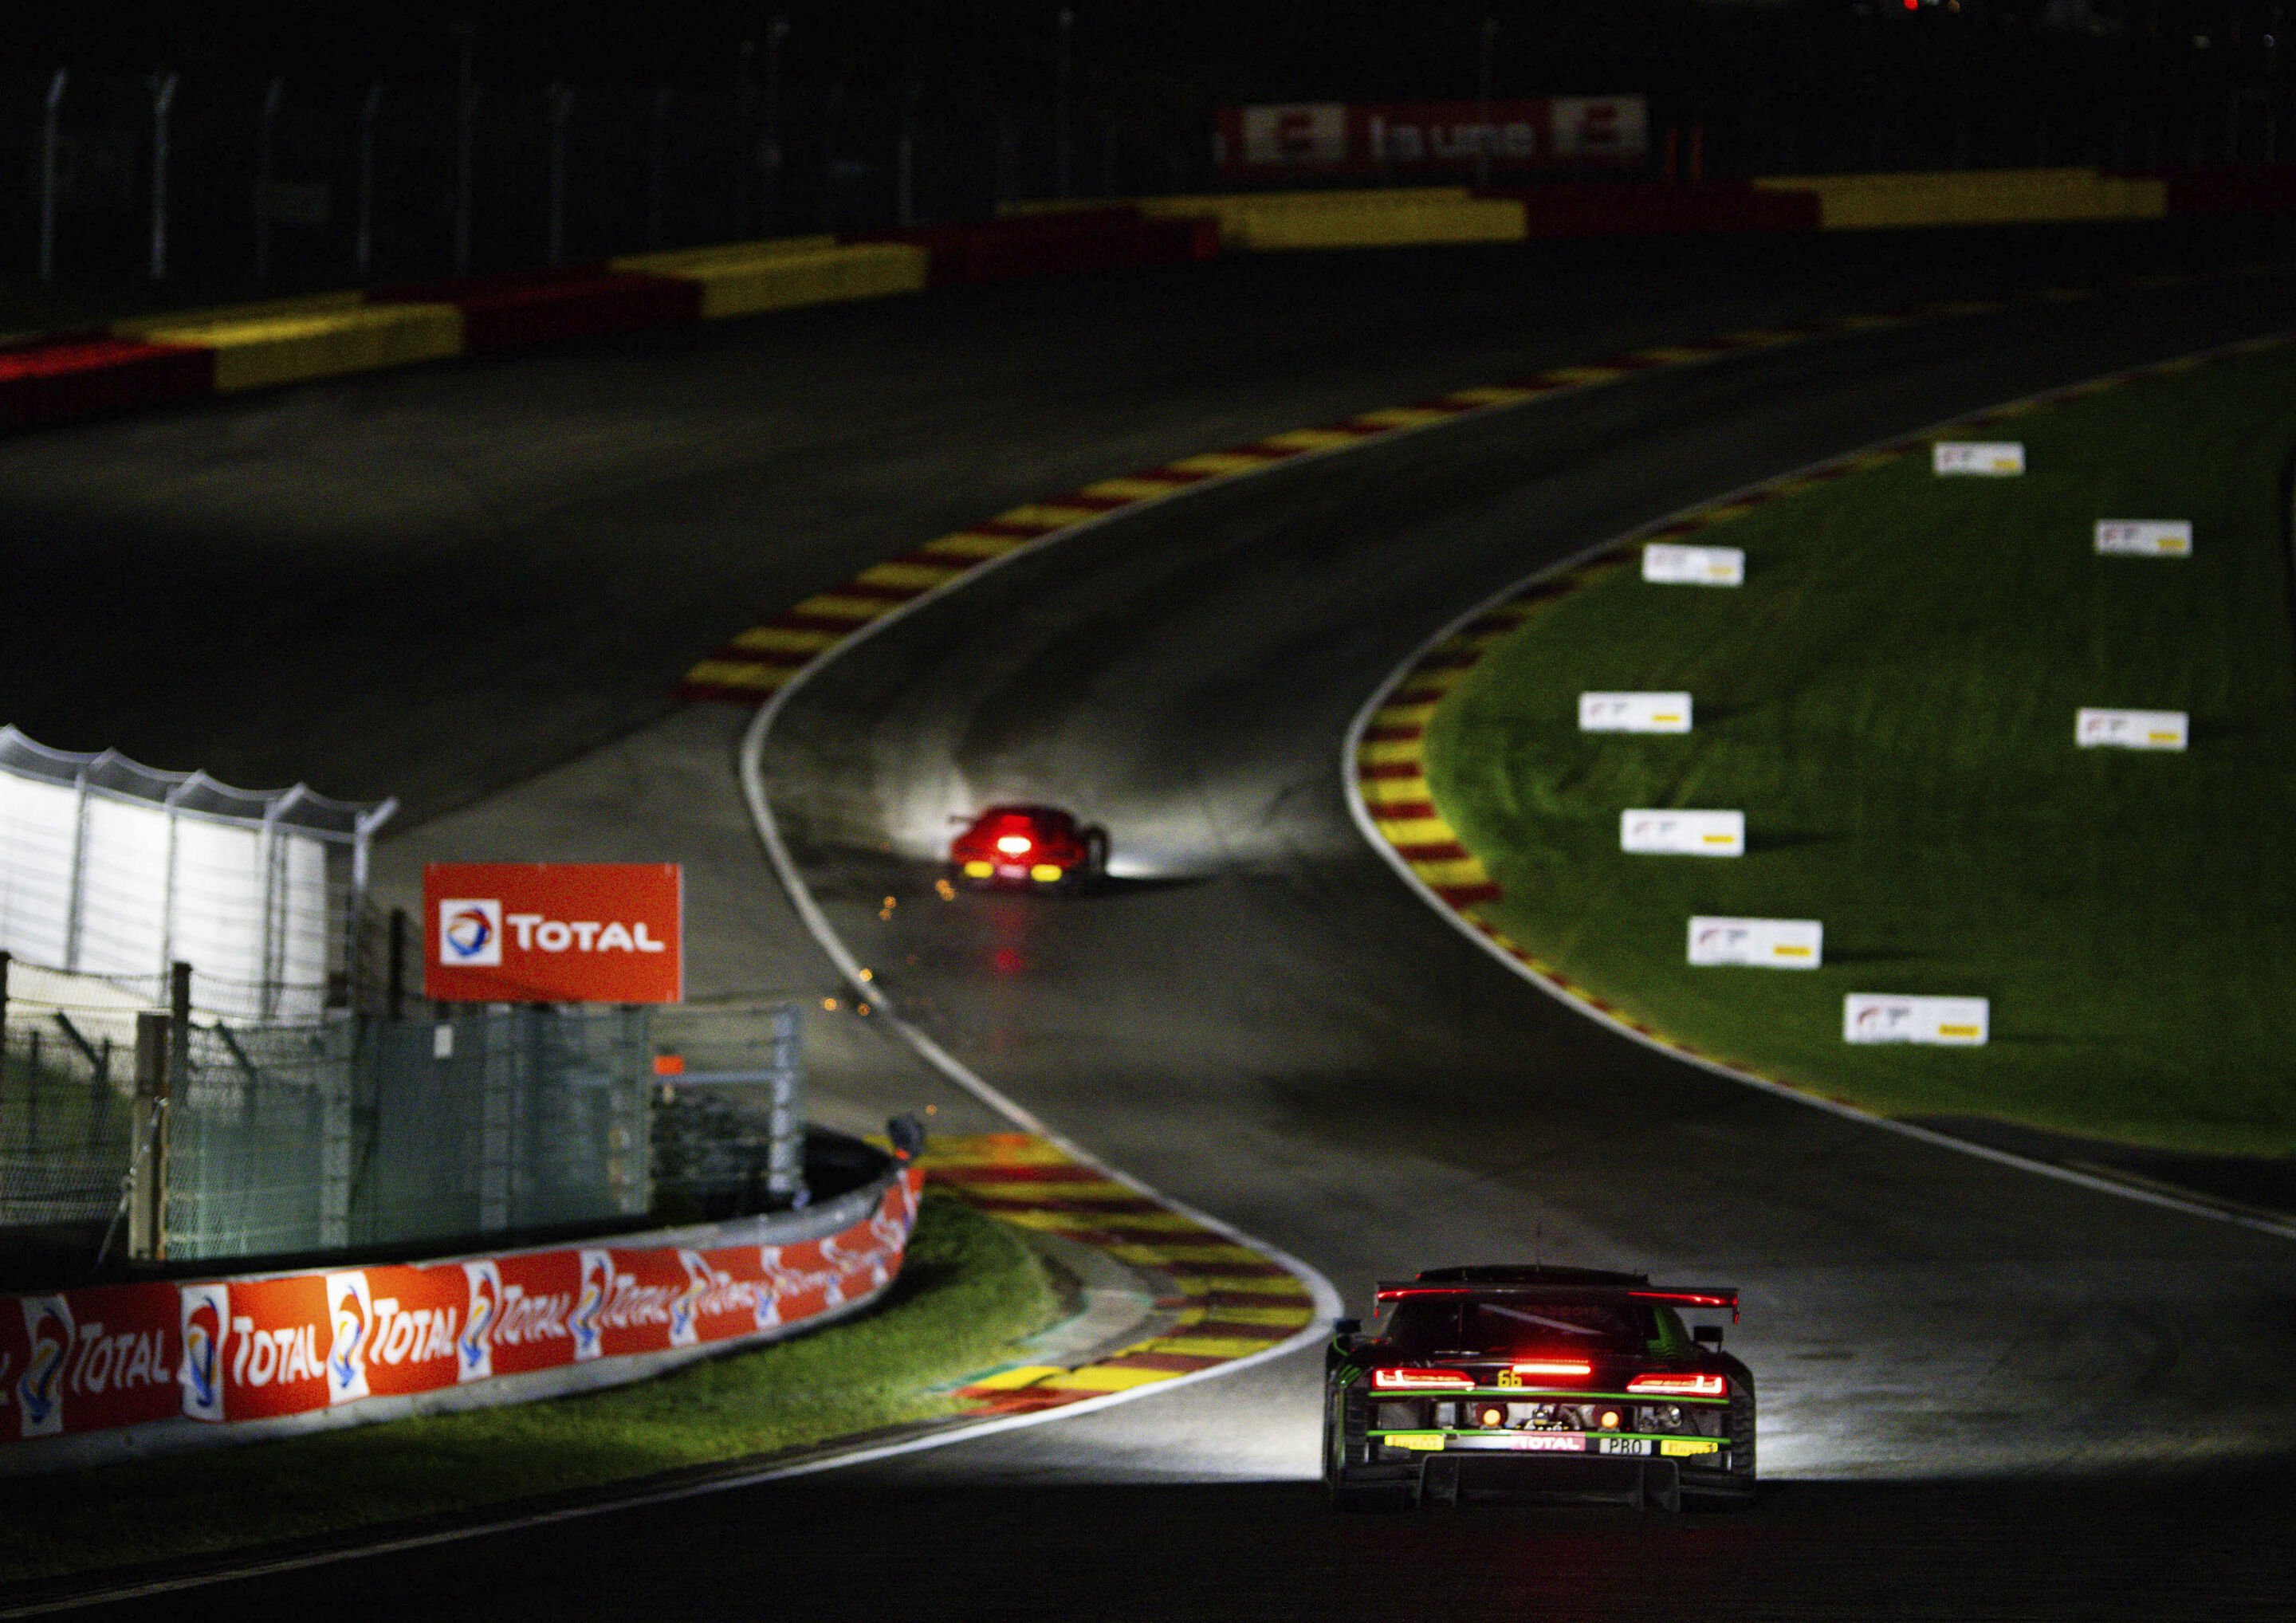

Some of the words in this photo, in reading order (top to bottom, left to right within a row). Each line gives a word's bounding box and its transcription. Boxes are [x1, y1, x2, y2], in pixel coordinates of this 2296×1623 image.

[505, 914, 666, 953] TOTAL
[233, 1316, 326, 1386] TOTAL
[371, 1298, 457, 1365] TOTAL
[71, 1322, 171, 1394] TOTAL
[1497, 1370, 1522, 1387] 66
[1518, 1437, 1580, 1451] TOTAL
[1609, 1439, 1642, 1454] PRO
